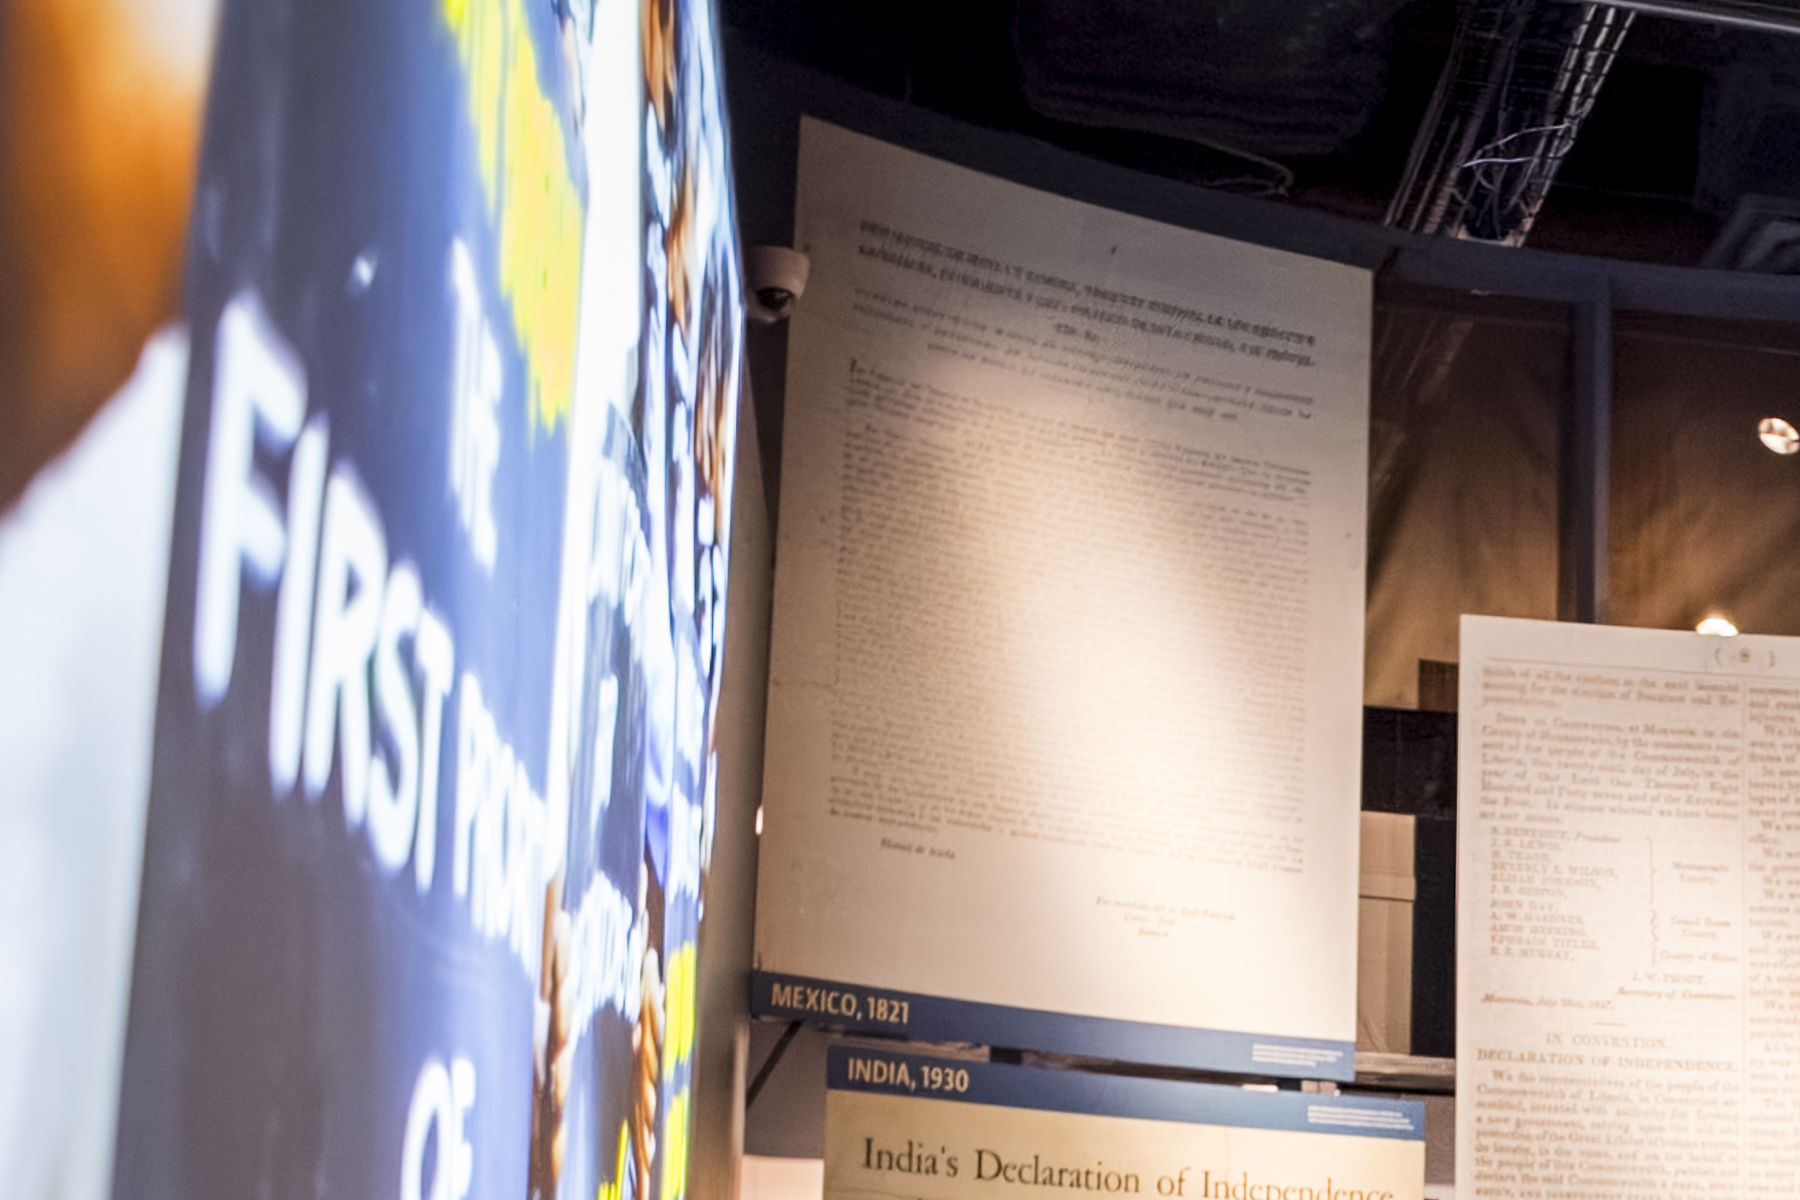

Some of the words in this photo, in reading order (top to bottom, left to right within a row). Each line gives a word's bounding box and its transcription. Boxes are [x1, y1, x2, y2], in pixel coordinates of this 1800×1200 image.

[193, 287, 454, 893] FIRST
[771, 982, 862, 1022] MEXICO,
[867, 996, 910, 1025] 1821
[848, 1057, 916, 1093] INDIA,
[921, 1065, 970, 1093] 1930
[863, 1137, 959, 1179] India's
[974, 1148, 1141, 1193] Declaration
[1156, 1166, 1191, 1198] of
